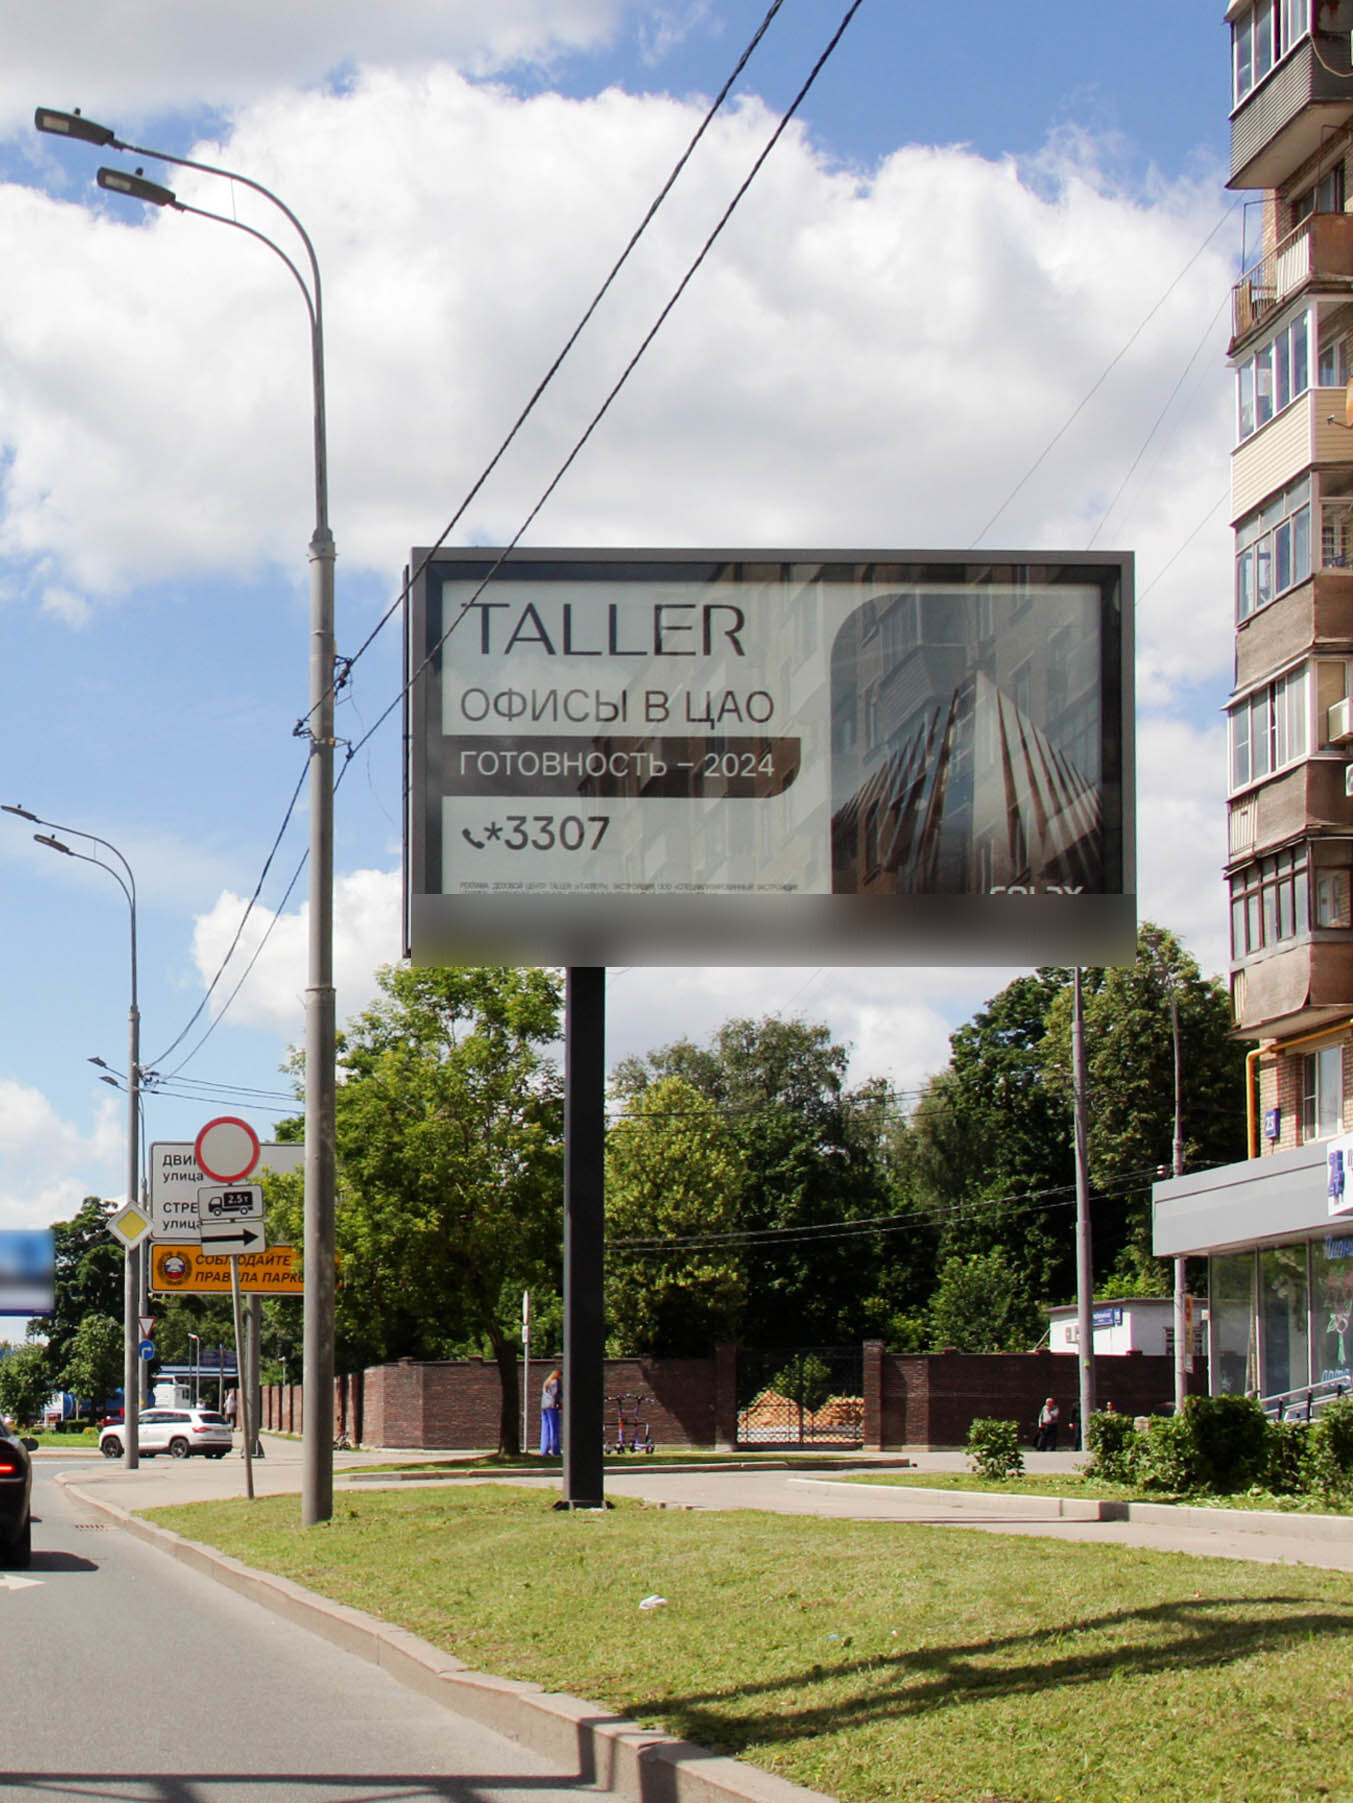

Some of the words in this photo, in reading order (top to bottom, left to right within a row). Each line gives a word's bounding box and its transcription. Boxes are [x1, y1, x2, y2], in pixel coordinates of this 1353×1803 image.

[461, 602, 746, 657] TALLER
[461, 687, 628, 723] ОФИСЫ
[644, 690, 670, 723] В
[685, 690, 775, 730] ЦАО
[460, 750, 668, 777] ГОТОВНОСТЬ
[703, 752, 776, 777] 2024
[162, 1172, 204, 1184] улица
[162, 1202, 200, 1214] СТРЕ
[194, 1271, 258, 1283] ПРАВЛА
